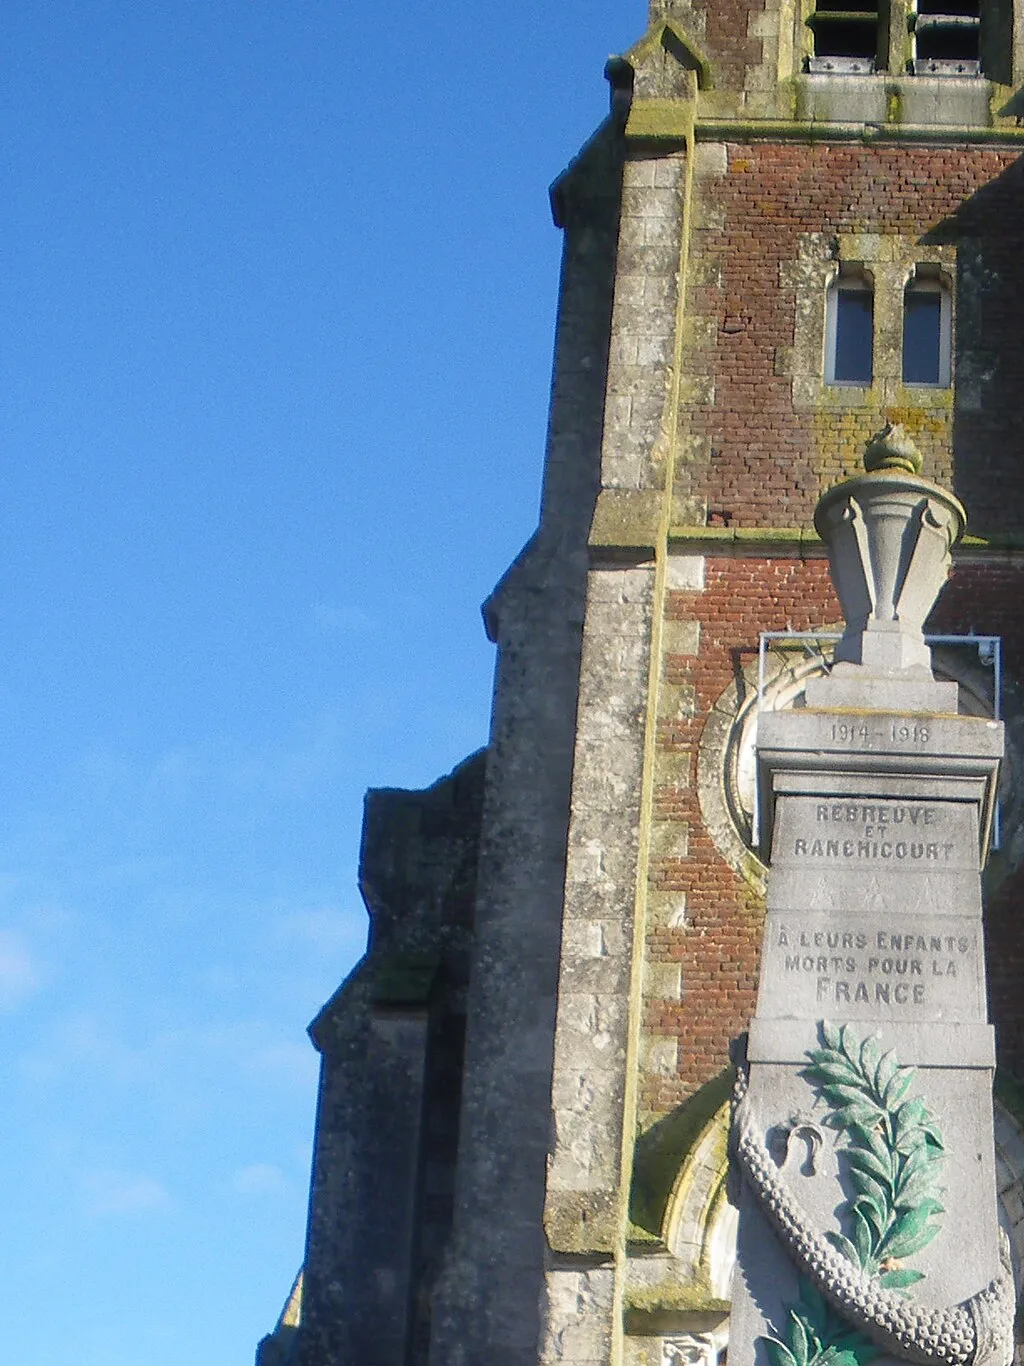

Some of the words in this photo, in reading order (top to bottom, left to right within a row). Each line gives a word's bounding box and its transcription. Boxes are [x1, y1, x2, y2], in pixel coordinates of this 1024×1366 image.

[831, 724, 869, 741] 1914
[890, 724, 930, 743] 1918
[816, 804, 935, 825] REBREUVE
[865, 826, 887, 839] ET
[794, 838, 955, 861] RANCHICOURT
[800, 931, 867, 950] LEURS
[877, 931, 969, 952] ENFANTS
[785, 956, 855, 972] MORTS
[868, 959, 922, 976] POUR
[932, 960, 957, 978] LA
[817, 978, 926, 1004] FRANCE
